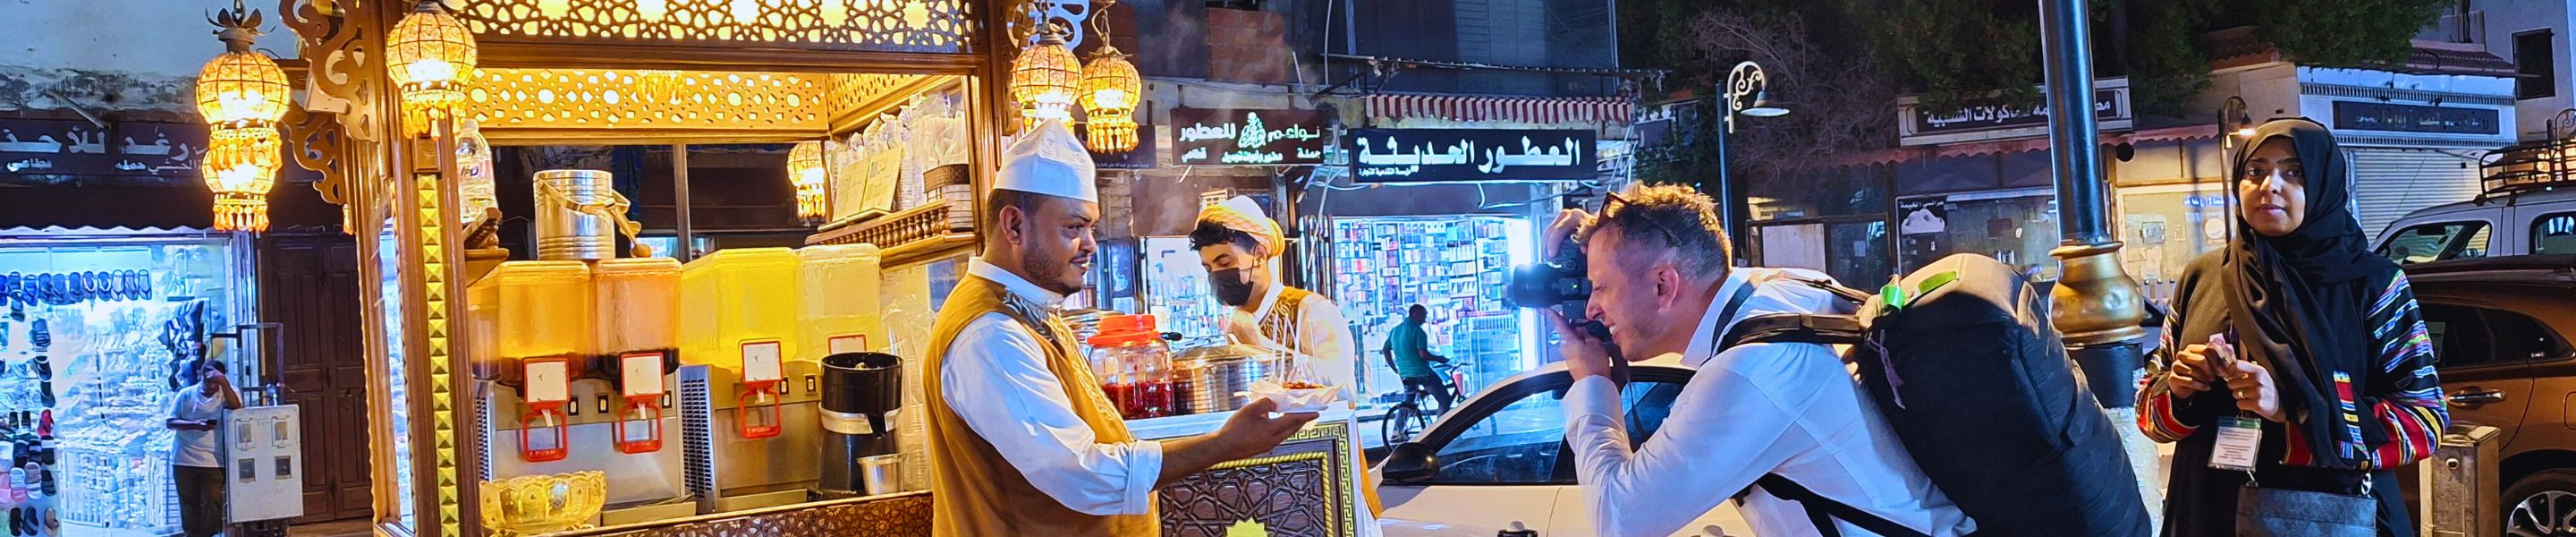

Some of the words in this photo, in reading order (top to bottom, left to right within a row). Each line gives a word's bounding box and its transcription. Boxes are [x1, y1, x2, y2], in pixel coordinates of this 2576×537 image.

[1179, 122, 1237, 142] للعطور
[1267, 123, 1321, 142] نواعم
[1356, 135, 1475, 166] الحديثة
[1477, 135, 1581, 174] العطور
